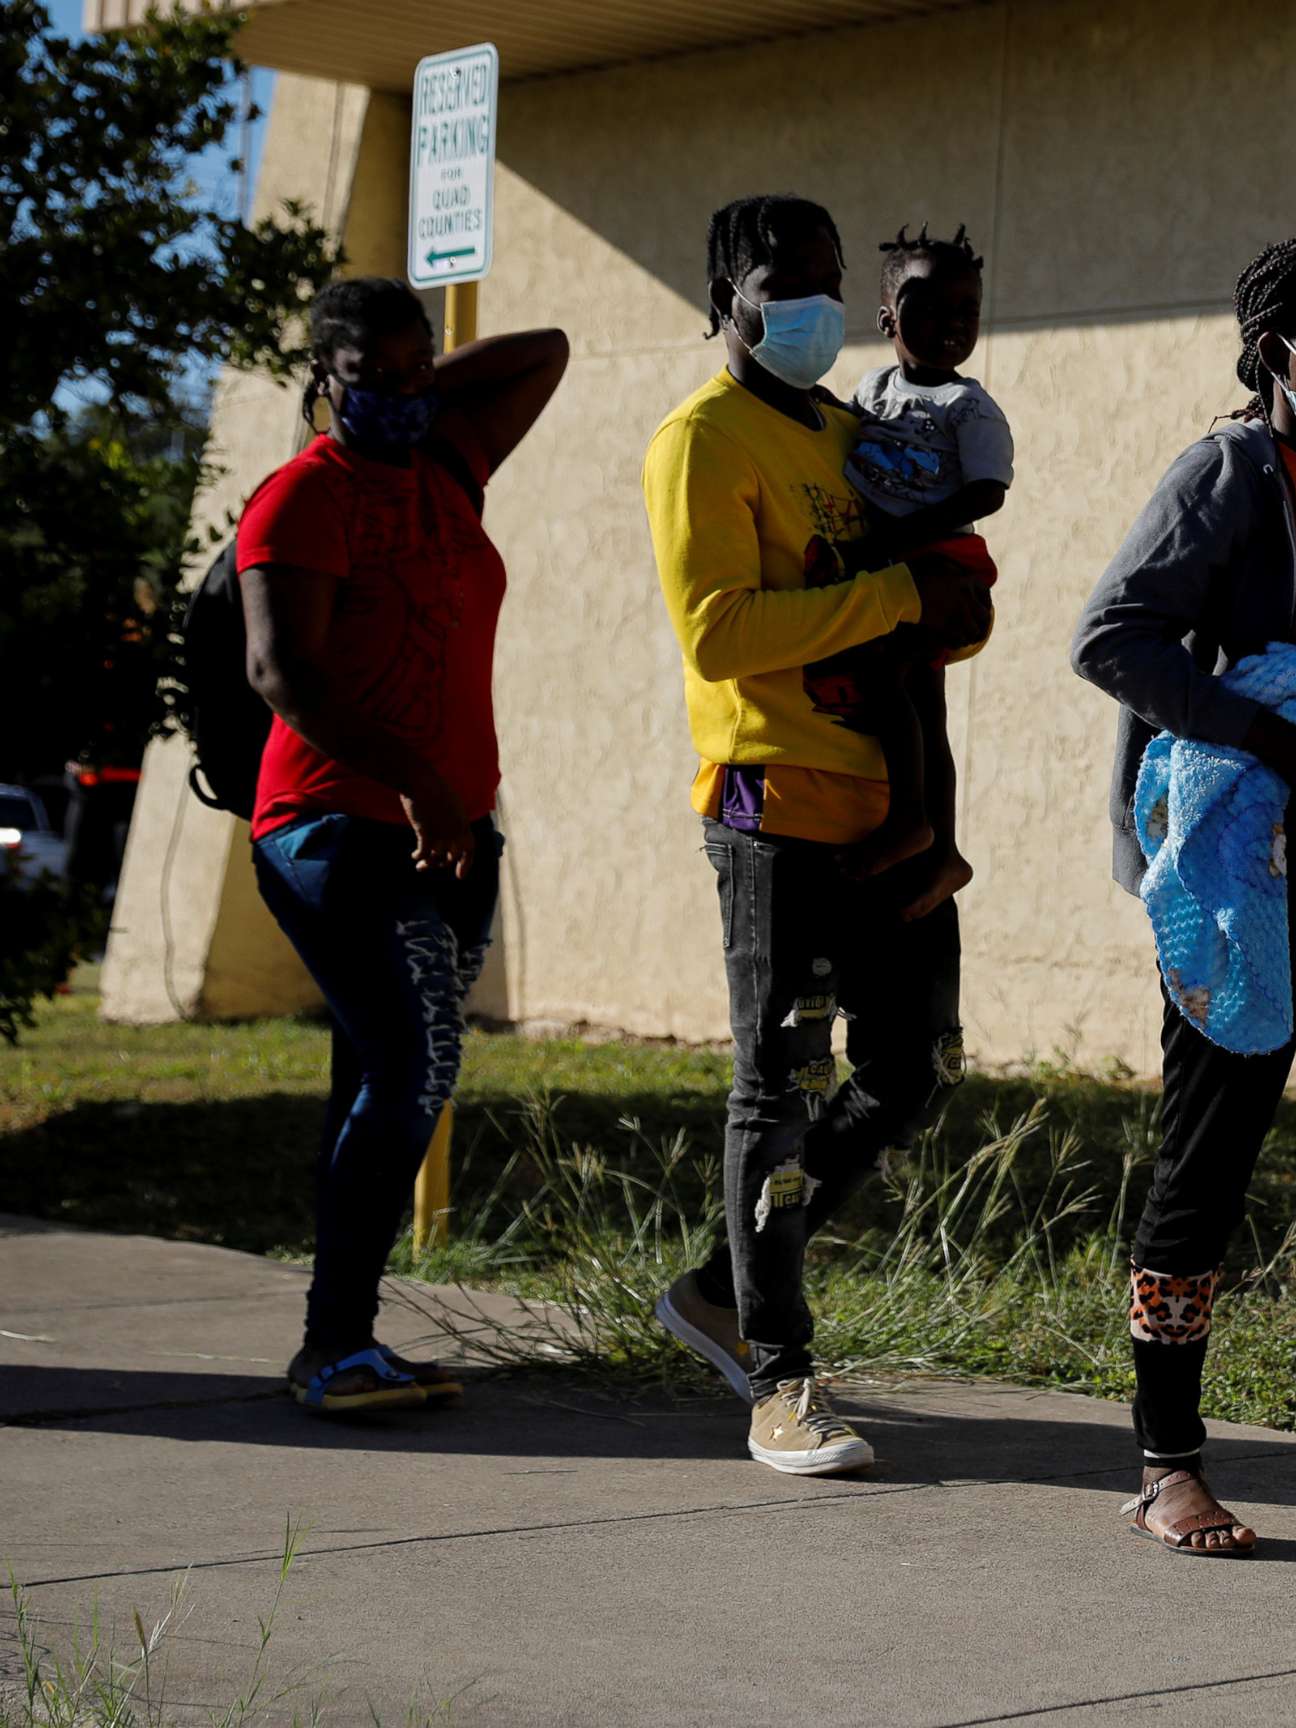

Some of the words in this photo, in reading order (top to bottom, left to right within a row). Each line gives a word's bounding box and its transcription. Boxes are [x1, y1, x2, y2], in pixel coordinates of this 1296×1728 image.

[419, 65, 487, 115] RESERVED
[417, 116, 489, 166] PARKING
[440, 168, 462, 182] FOR
[433, 186, 470, 210] QUAD
[419, 209, 481, 239] COUNTIES
